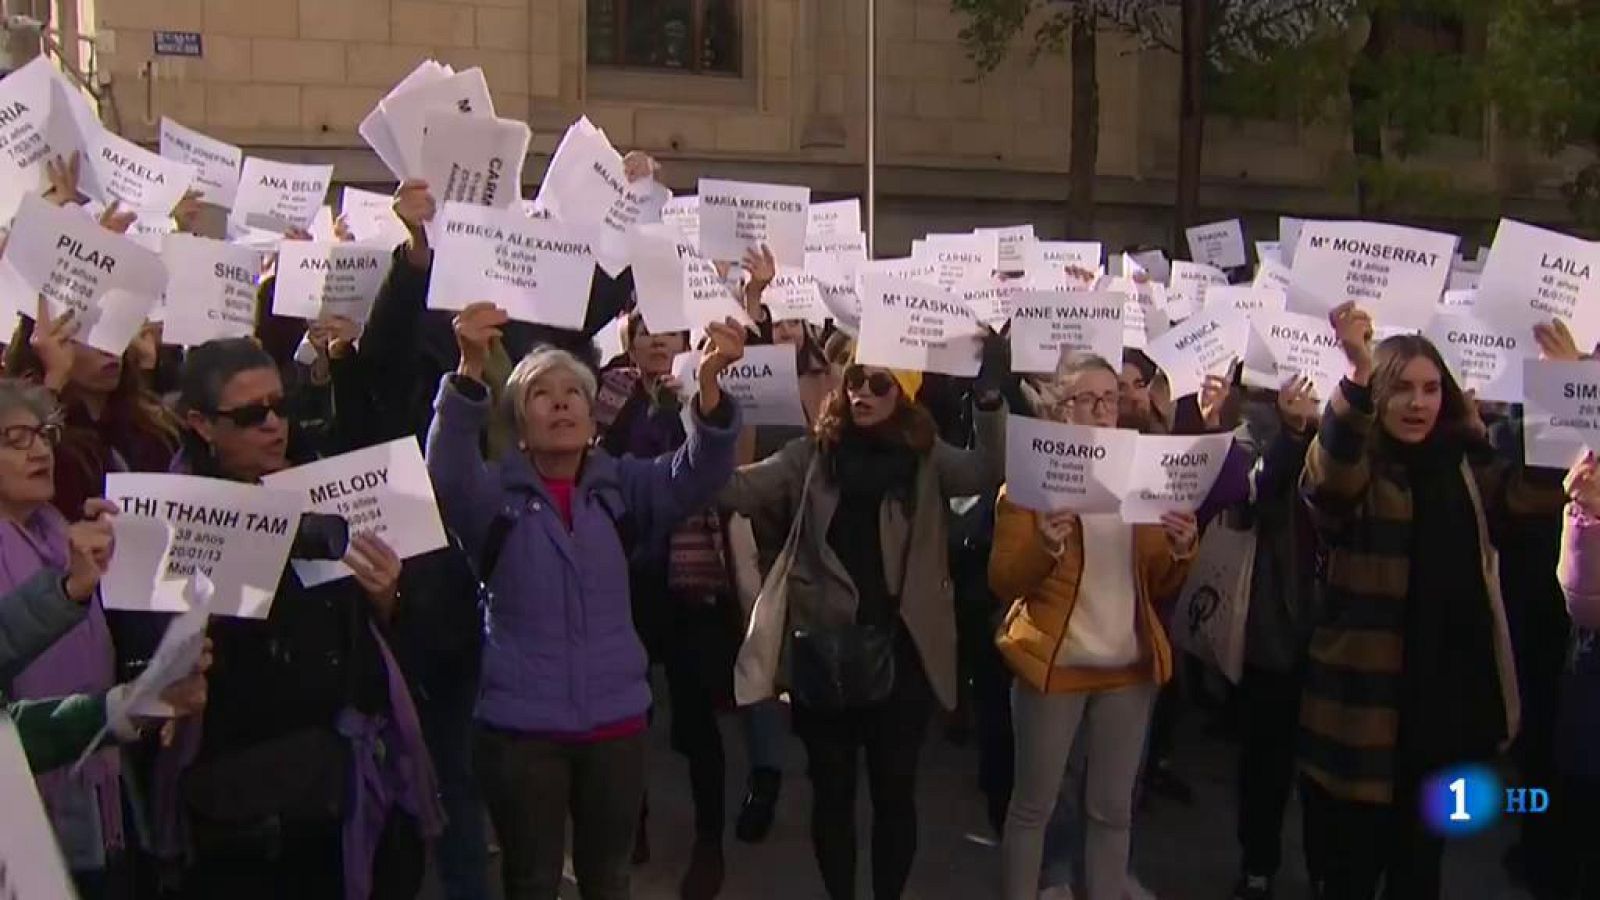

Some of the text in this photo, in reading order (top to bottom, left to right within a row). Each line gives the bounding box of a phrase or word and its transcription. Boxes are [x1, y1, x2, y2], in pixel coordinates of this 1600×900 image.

[101, 147, 165, 184] RAFAELA
[260, 175, 288, 190] ANA
[740, 197, 801, 213] MERCEDES
[446, 220, 592, 256] REBECA ALEXANDRA
[57, 234, 116, 273] PILAR
[938, 253, 981, 263] CARMEN
[1333, 238, 1438, 268] MONSERRAT
[300, 257, 331, 271] ANA
[1541, 253, 1590, 280] LAILA
[905, 296, 970, 318] IZASKUN
[1015, 306, 1053, 320] ANNE
[1056, 306, 1121, 320] WANJIRU
[1271, 323, 1310, 344] ROSA
[1447, 330, 1517, 350] CARIDAD
[720, 363, 773, 380] PAOLA
[1563, 383, 1600, 399] SIM
[1031, 438, 1107, 460] ROSARIO
[1160, 452, 1209, 468] ZHOUR
[309, 467, 389, 505] MELODY
[120, 496, 288, 537] THI THANH TAM
[193, 532, 225, 545] años
[167, 560, 213, 577] Madid
